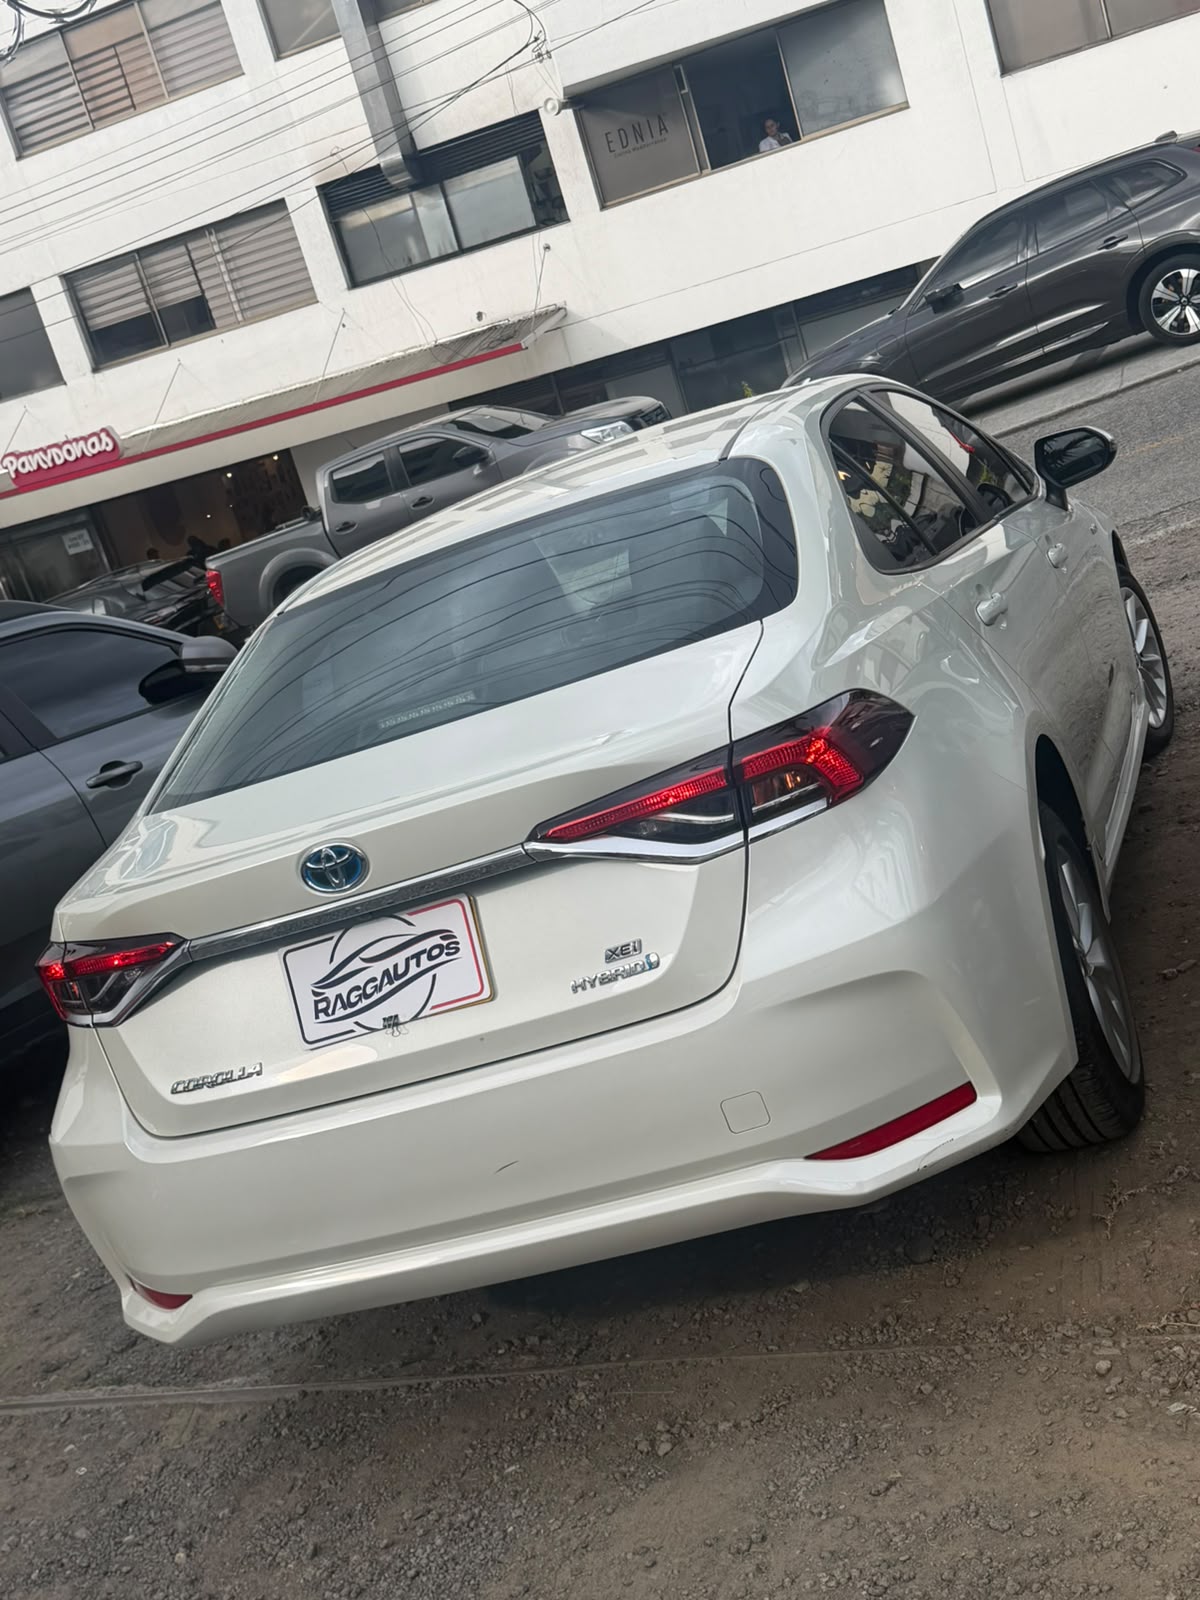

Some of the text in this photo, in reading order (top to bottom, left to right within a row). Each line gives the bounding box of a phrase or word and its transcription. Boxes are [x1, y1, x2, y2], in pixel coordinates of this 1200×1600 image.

[604, 114, 668, 153] EDNIA
[314, 940, 461, 1010] RAGGAUTOS
[571, 960, 646, 994] HYBRID
[171, 1062, 263, 1095] COROLLA
